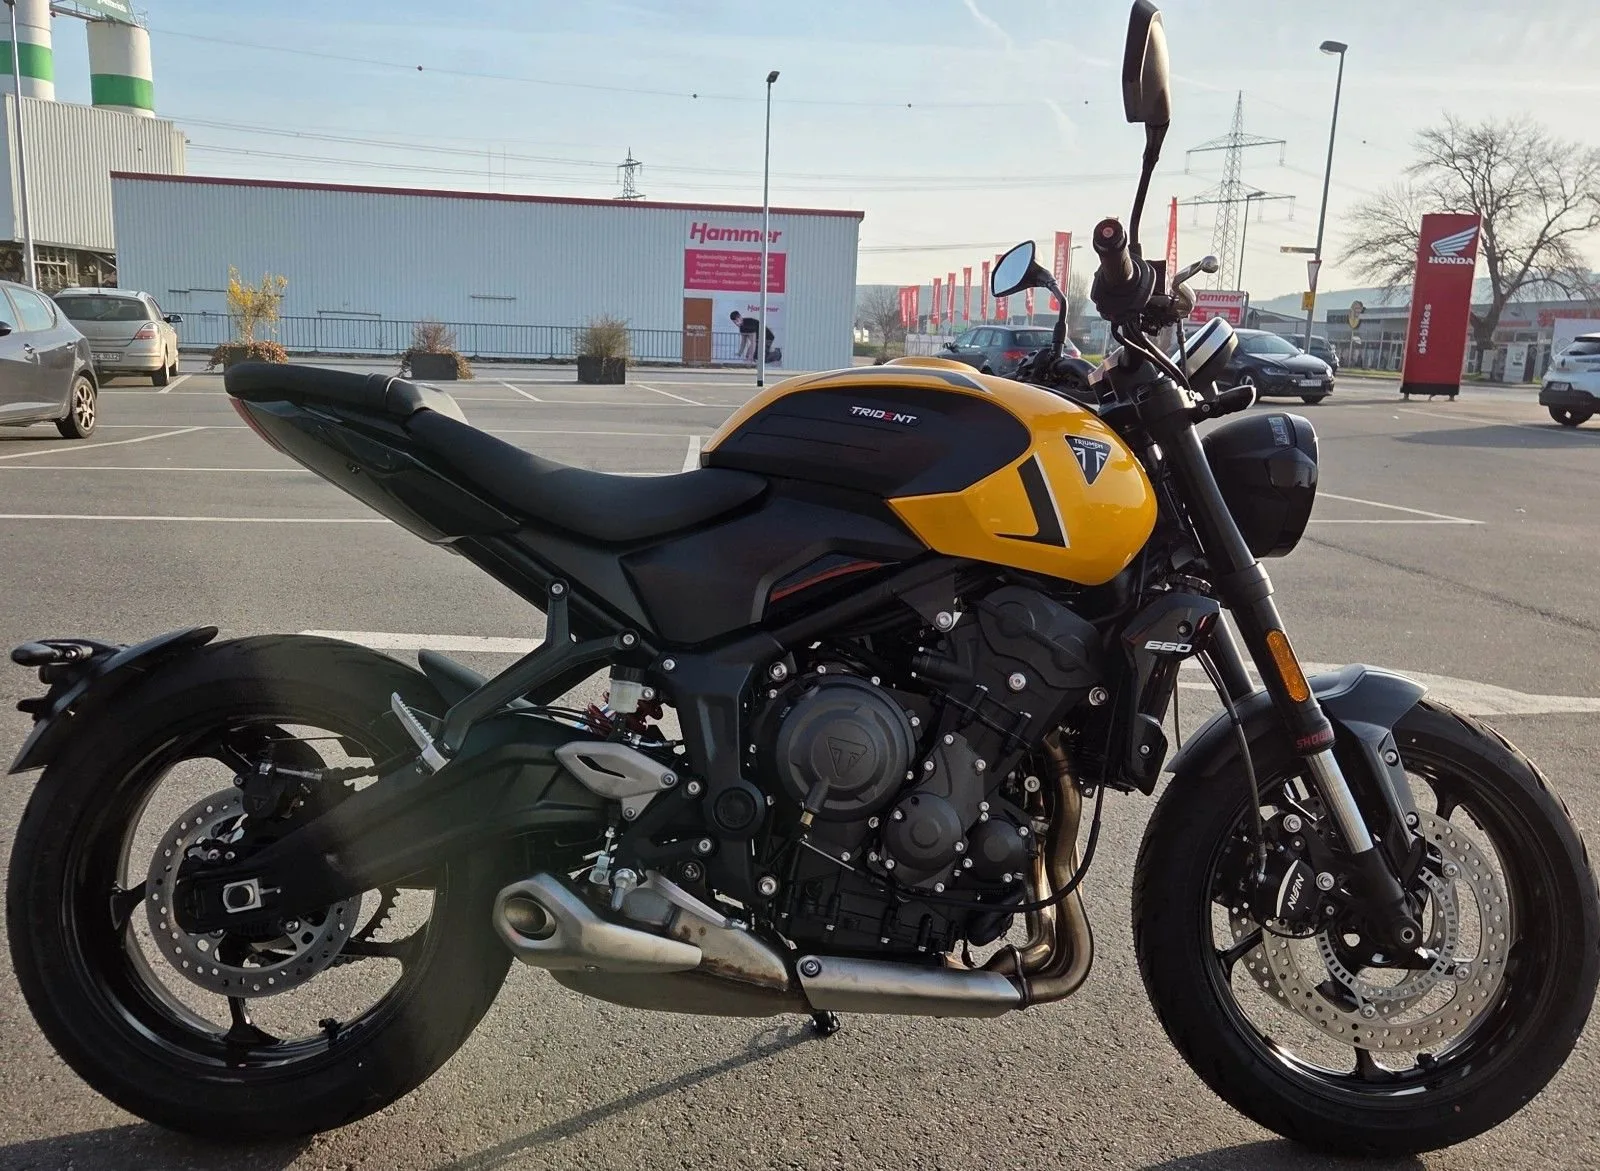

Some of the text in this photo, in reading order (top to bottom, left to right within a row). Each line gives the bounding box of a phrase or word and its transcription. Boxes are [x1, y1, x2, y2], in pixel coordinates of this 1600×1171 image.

[1428, 256, 1474, 265] HONDA
[747, 304, 780, 313] Hamer
[1418, 303, 1432, 354] sk-bikes
[851, 406, 917, 423] TRIDENT
[1073, 438, 1104, 450] TRIUMPH
[1144, 640, 1192, 653] 660
